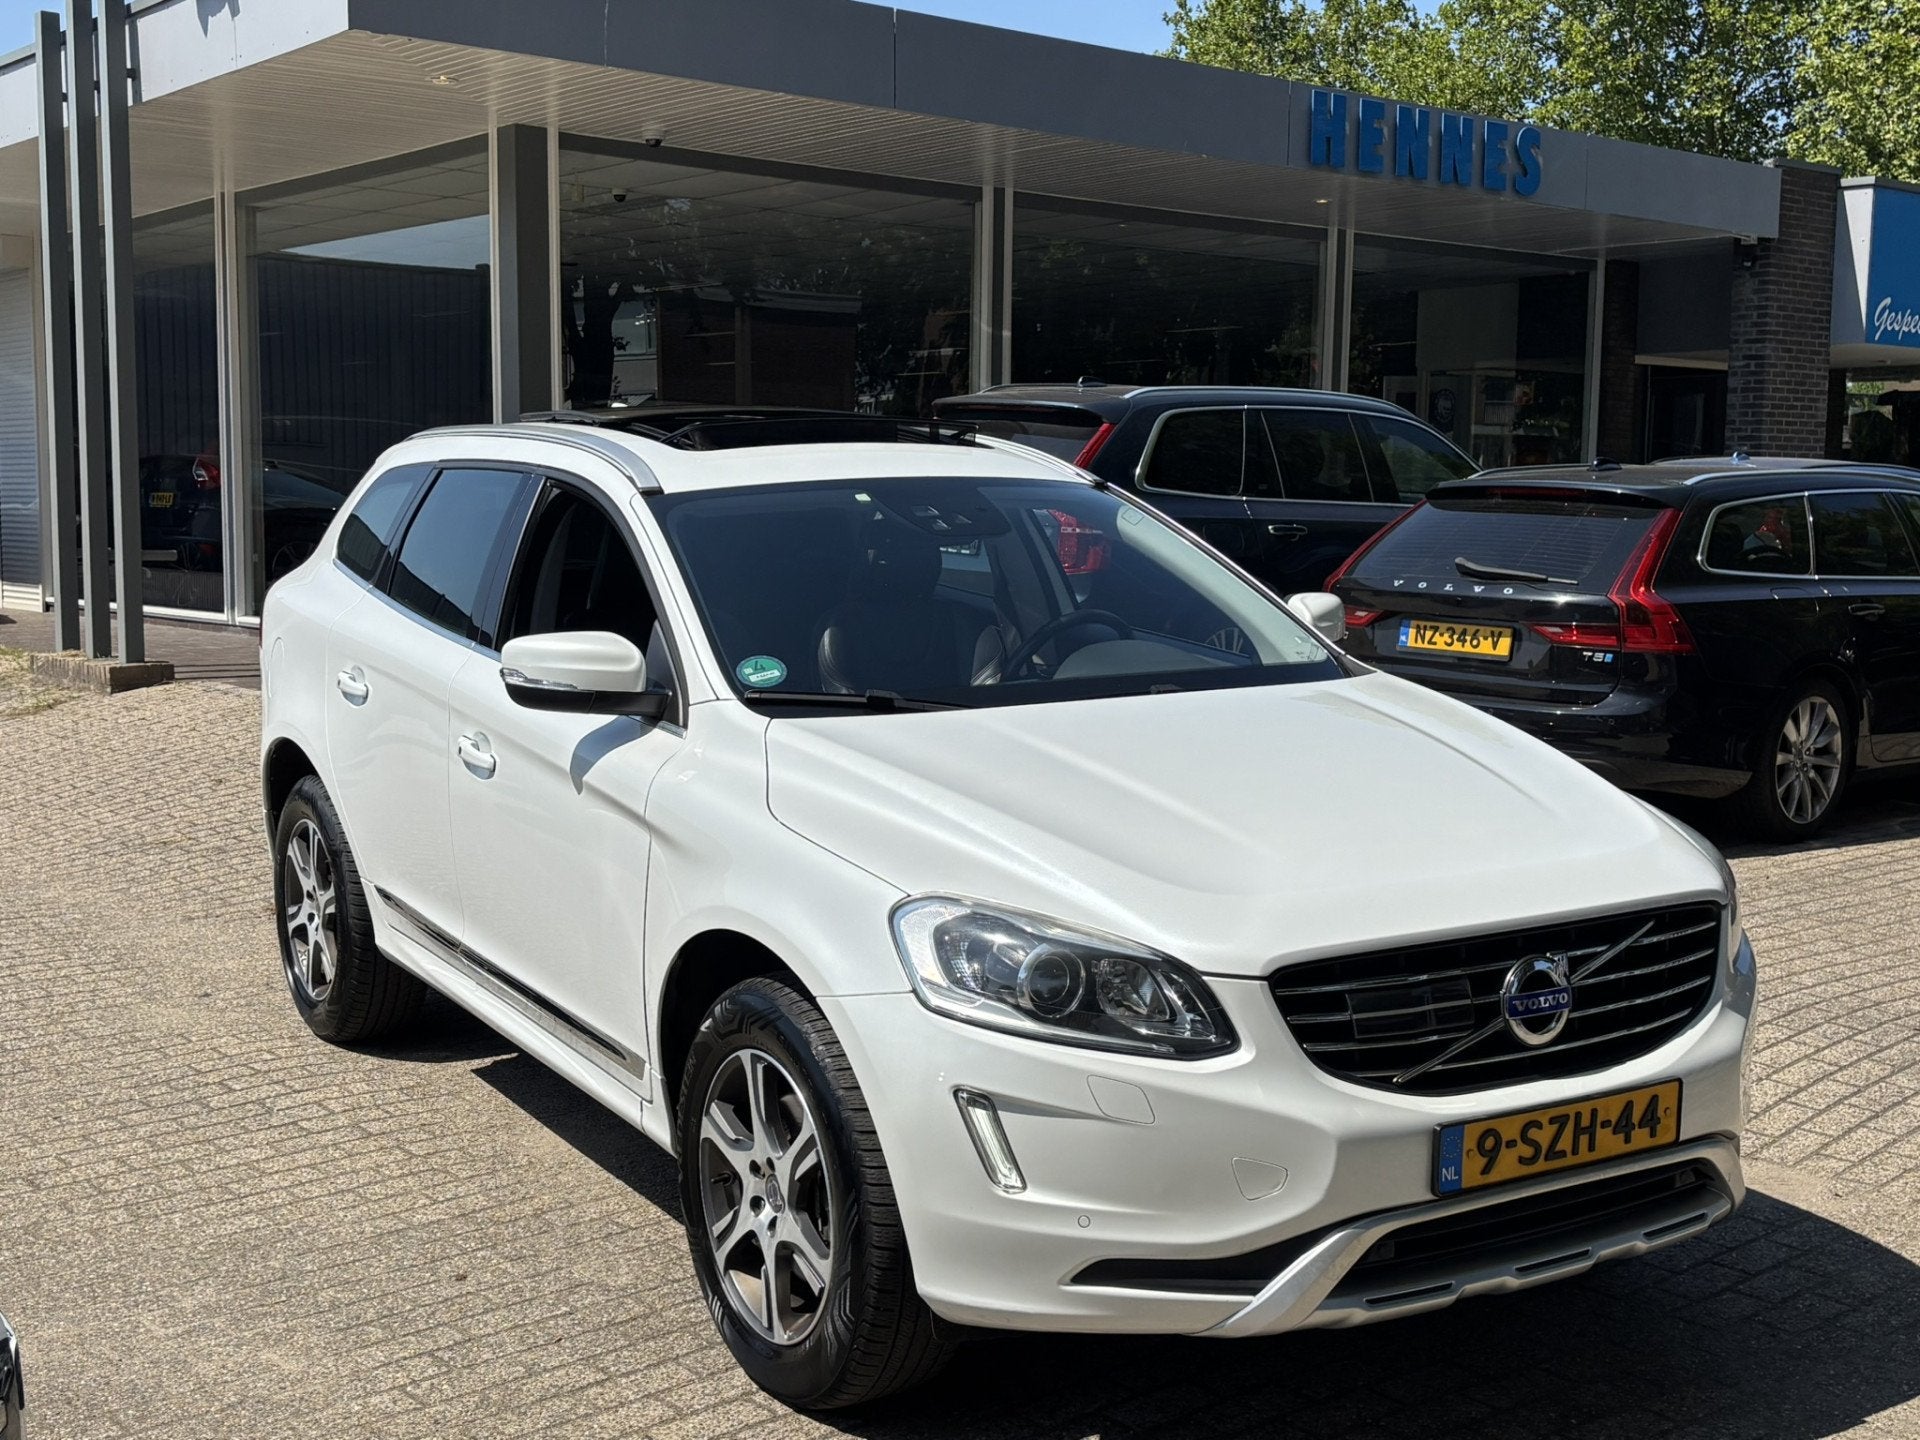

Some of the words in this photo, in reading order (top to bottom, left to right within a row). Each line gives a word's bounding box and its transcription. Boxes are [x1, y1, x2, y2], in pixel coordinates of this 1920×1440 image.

[1310, 88, 1542, 197] HENNES
[1393, 579, 1514, 595] VOLVO
[1414, 624, 1503, 651] NZ-346-V
[1512, 992, 1569, 1012] VOLVO
[1441, 1166, 1459, 1182] NL
[1476, 1094, 1662, 1176] 9-SZH-44
